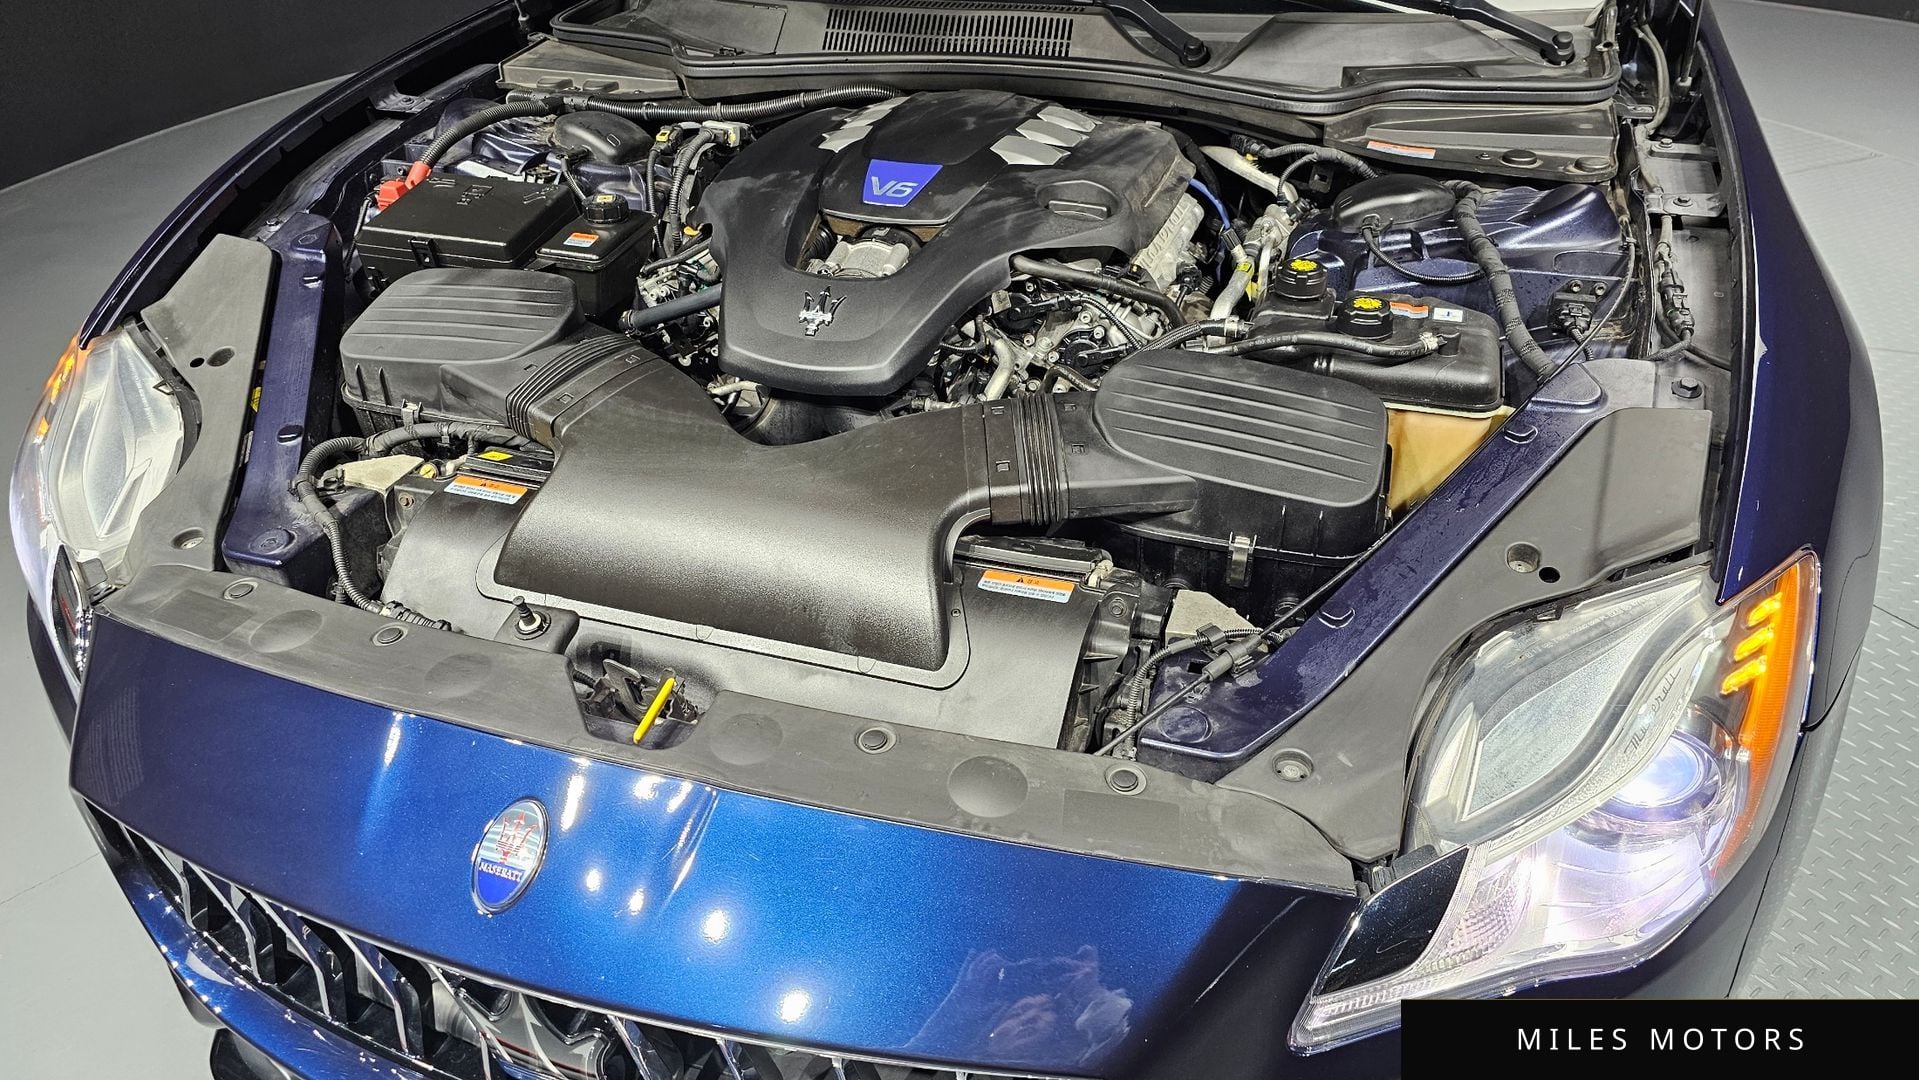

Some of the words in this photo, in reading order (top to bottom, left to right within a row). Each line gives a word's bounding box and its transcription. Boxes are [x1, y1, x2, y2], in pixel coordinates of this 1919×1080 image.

[871, 176, 919, 198] V6
[1623, 667, 1682, 755] Maerati
[478, 861, 523, 883] MASERATI
